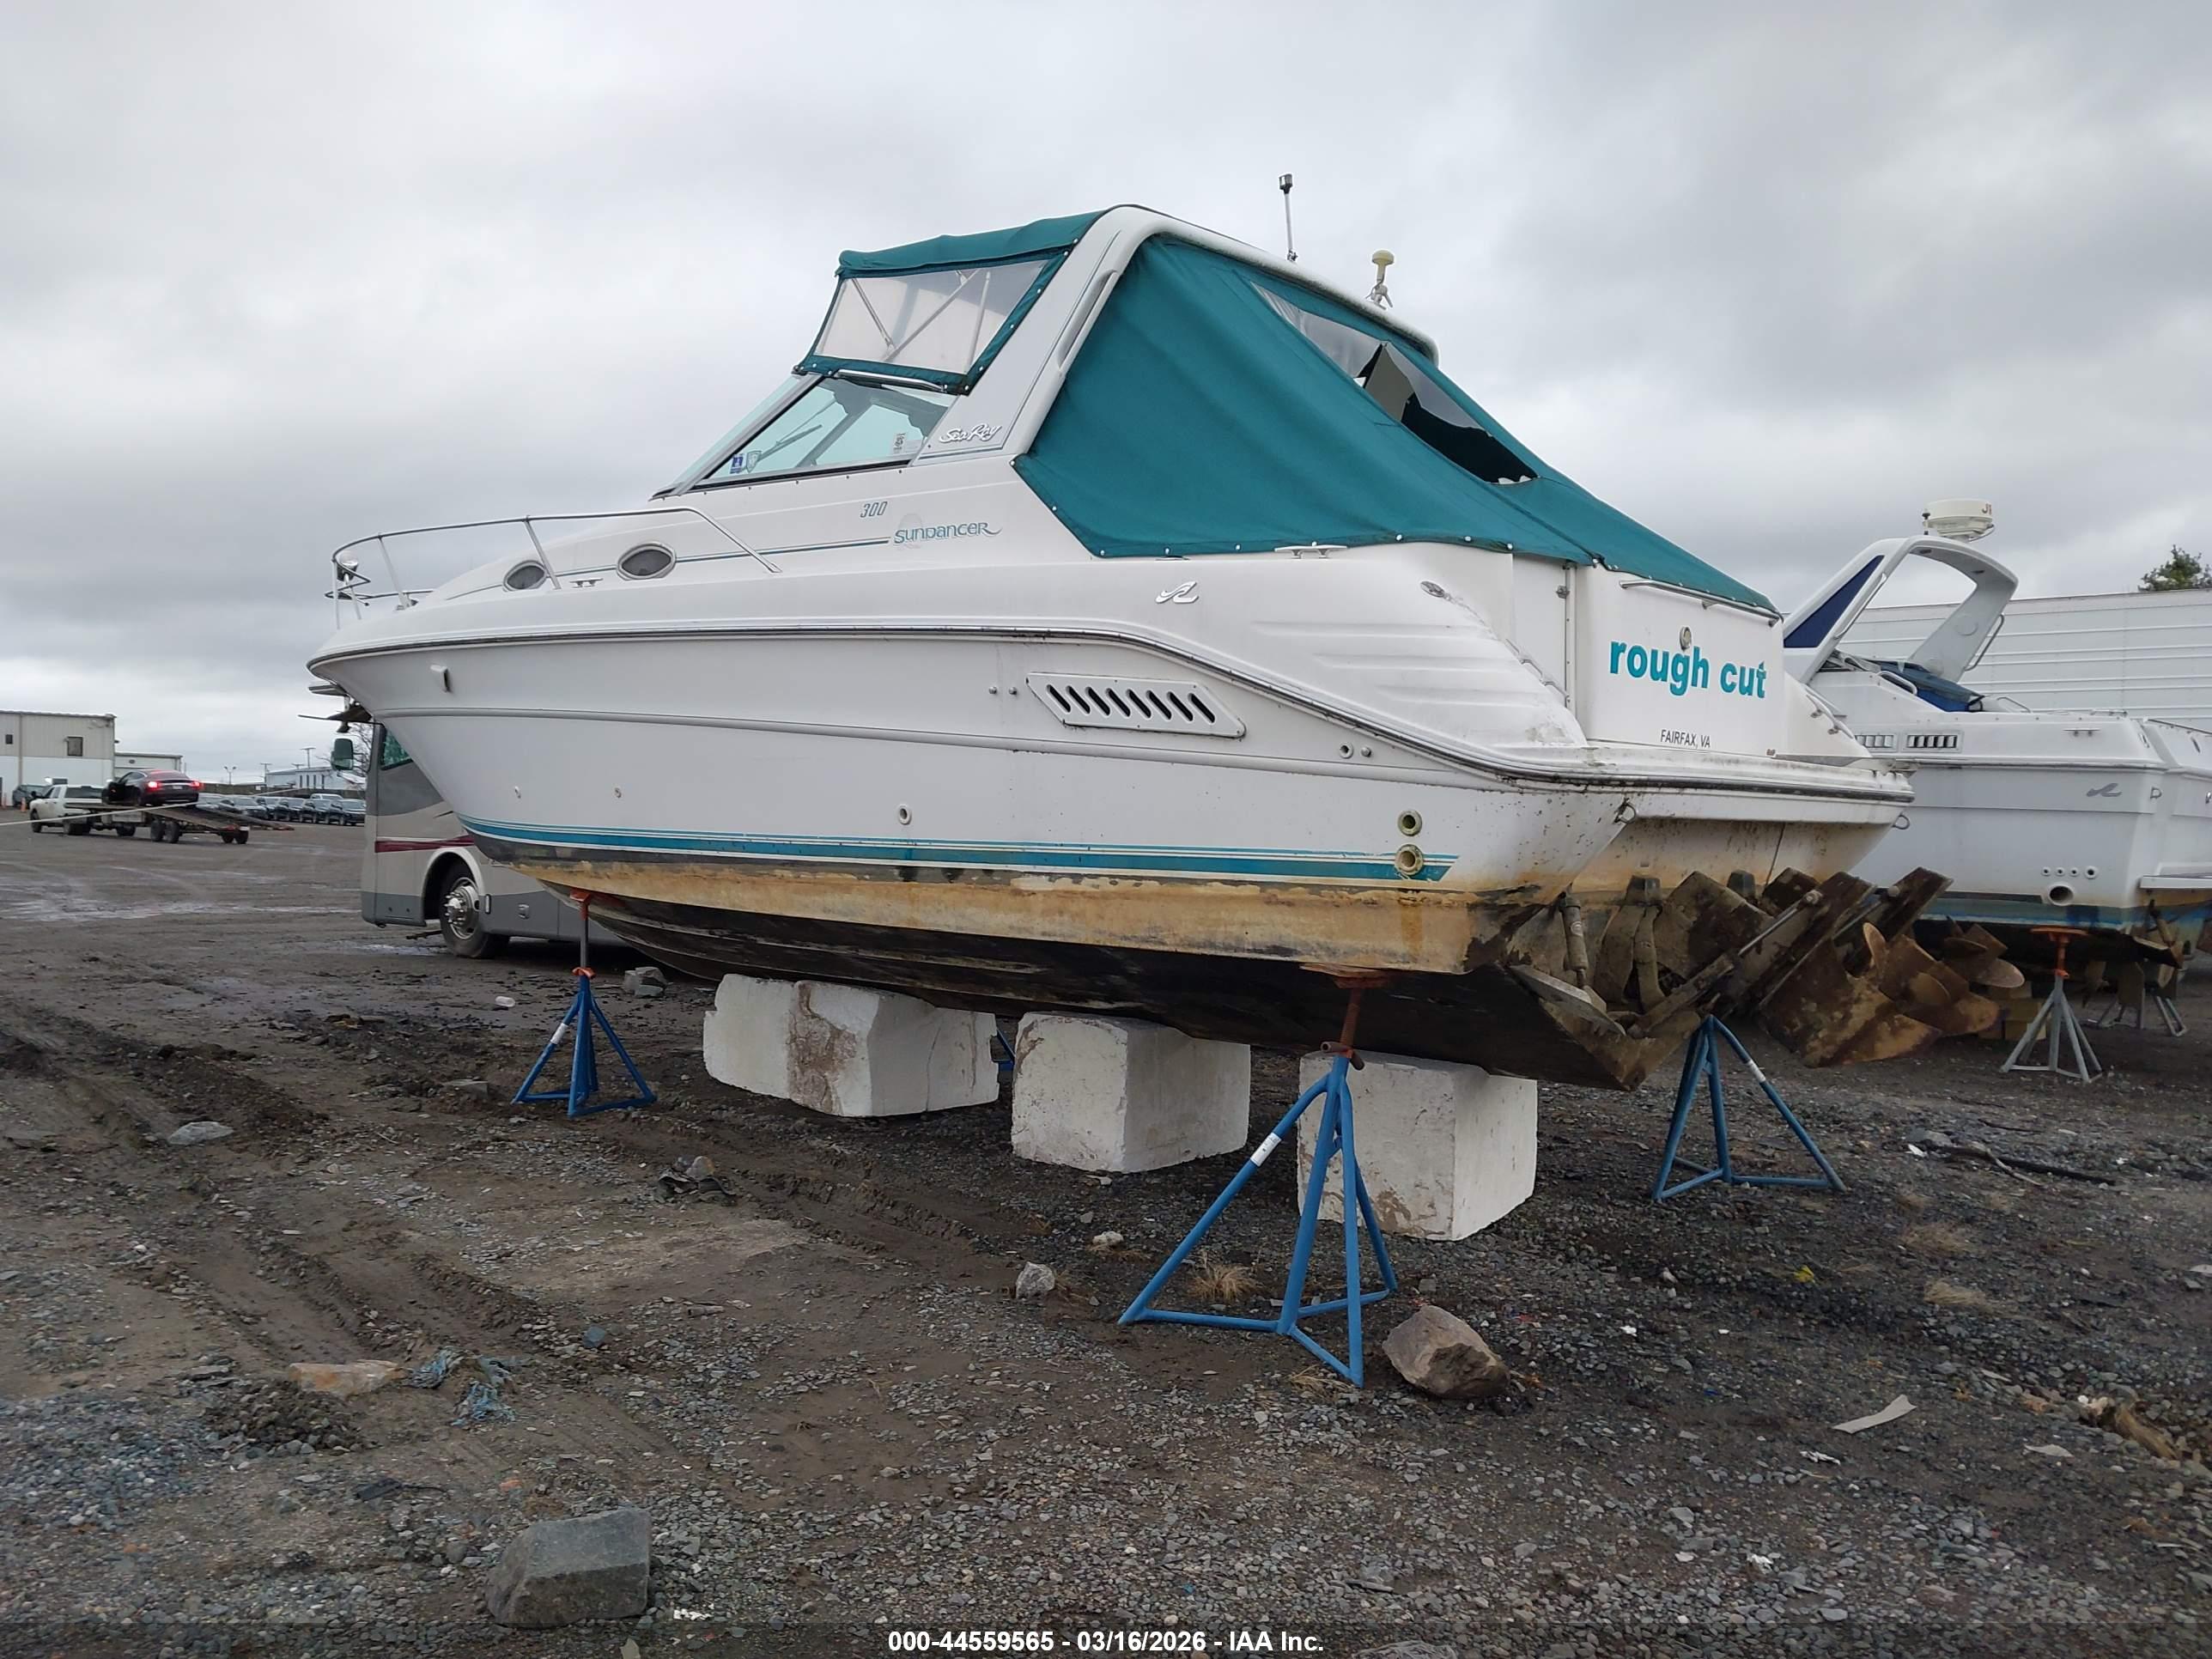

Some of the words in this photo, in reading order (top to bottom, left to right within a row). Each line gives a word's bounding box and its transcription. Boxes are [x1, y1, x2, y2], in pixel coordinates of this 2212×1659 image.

[939, 428, 969, 443] Sea
[968, 422, 1003, 442] Ray
[860, 501, 888, 518] 300
[1609, 641, 1710, 696] rough
[1720, 660, 1766, 699] cut
[1660, 729, 1699, 749] FAIRFAX,
[1700, 734, 1711, 748] VA
